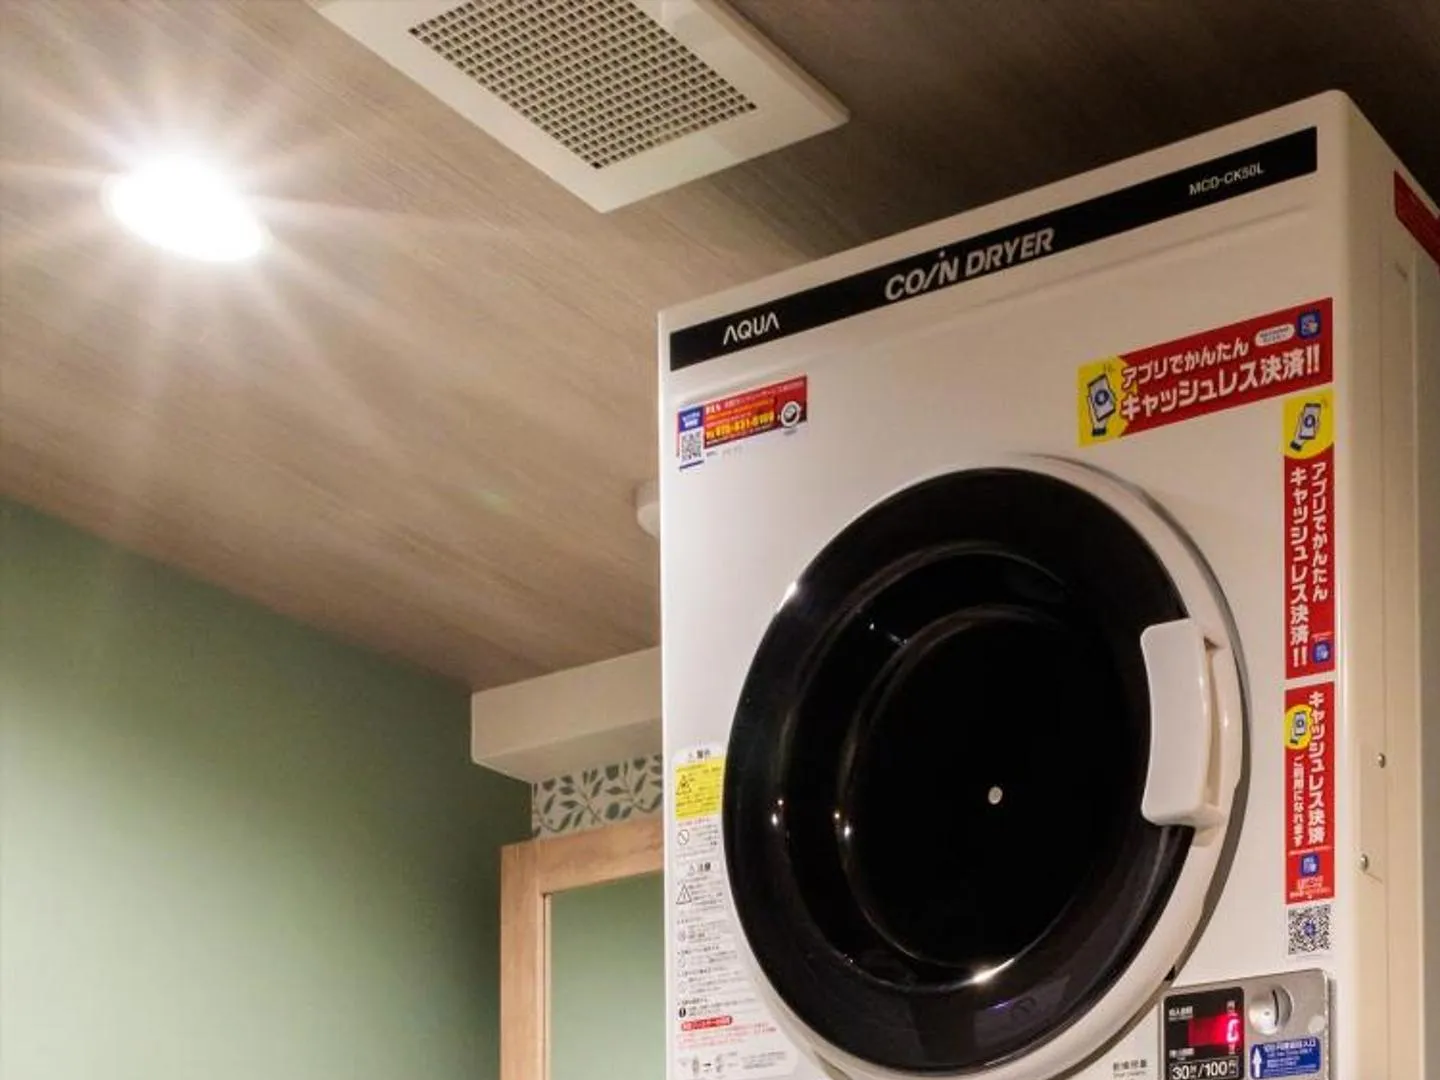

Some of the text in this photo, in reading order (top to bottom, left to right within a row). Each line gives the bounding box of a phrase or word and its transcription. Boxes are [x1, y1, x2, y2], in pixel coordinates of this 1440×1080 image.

[1188, 161, 1265, 196] MCD-CK50L
[965, 228, 1055, 280] DRYER
[723, 313, 780, 347] AQUA
[1122, 337, 1250, 389] アプリでかんたん
[1122, 344, 1320, 421] キャッシュレス決済!!
[1312, 461, 1328, 602] アプリでかんたん
[1308, 691, 1326, 845] キャッシュレス決済
